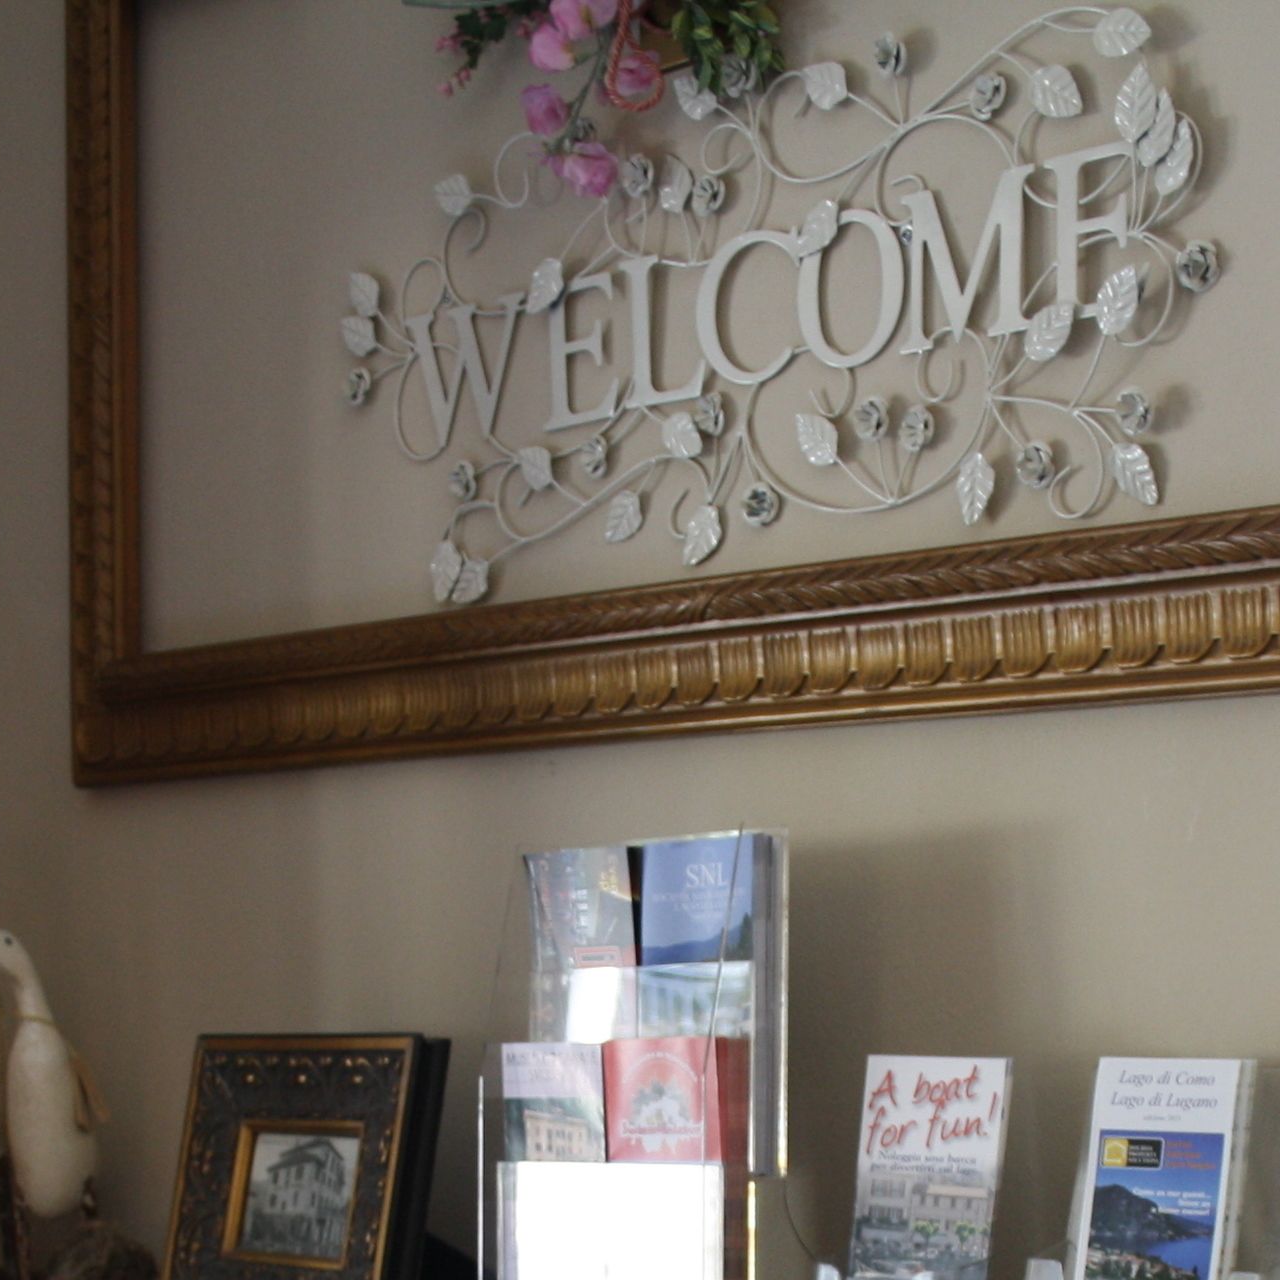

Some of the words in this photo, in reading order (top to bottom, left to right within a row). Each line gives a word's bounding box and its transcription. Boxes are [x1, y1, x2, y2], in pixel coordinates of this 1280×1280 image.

[868, 1069, 898, 1110] A
[912, 1064, 979, 1105] boat
[1118, 1070, 1154, 1087] Lago
[1156, 1070, 1171, 1085] di
[1175, 1071, 1216, 1086] Como
[1110, 1091, 1147, 1109] Lago
[1148, 1091, 1163, 1107] di
[1166, 1093, 1219, 1112] Lugano
[866, 1105, 918, 1155] for
